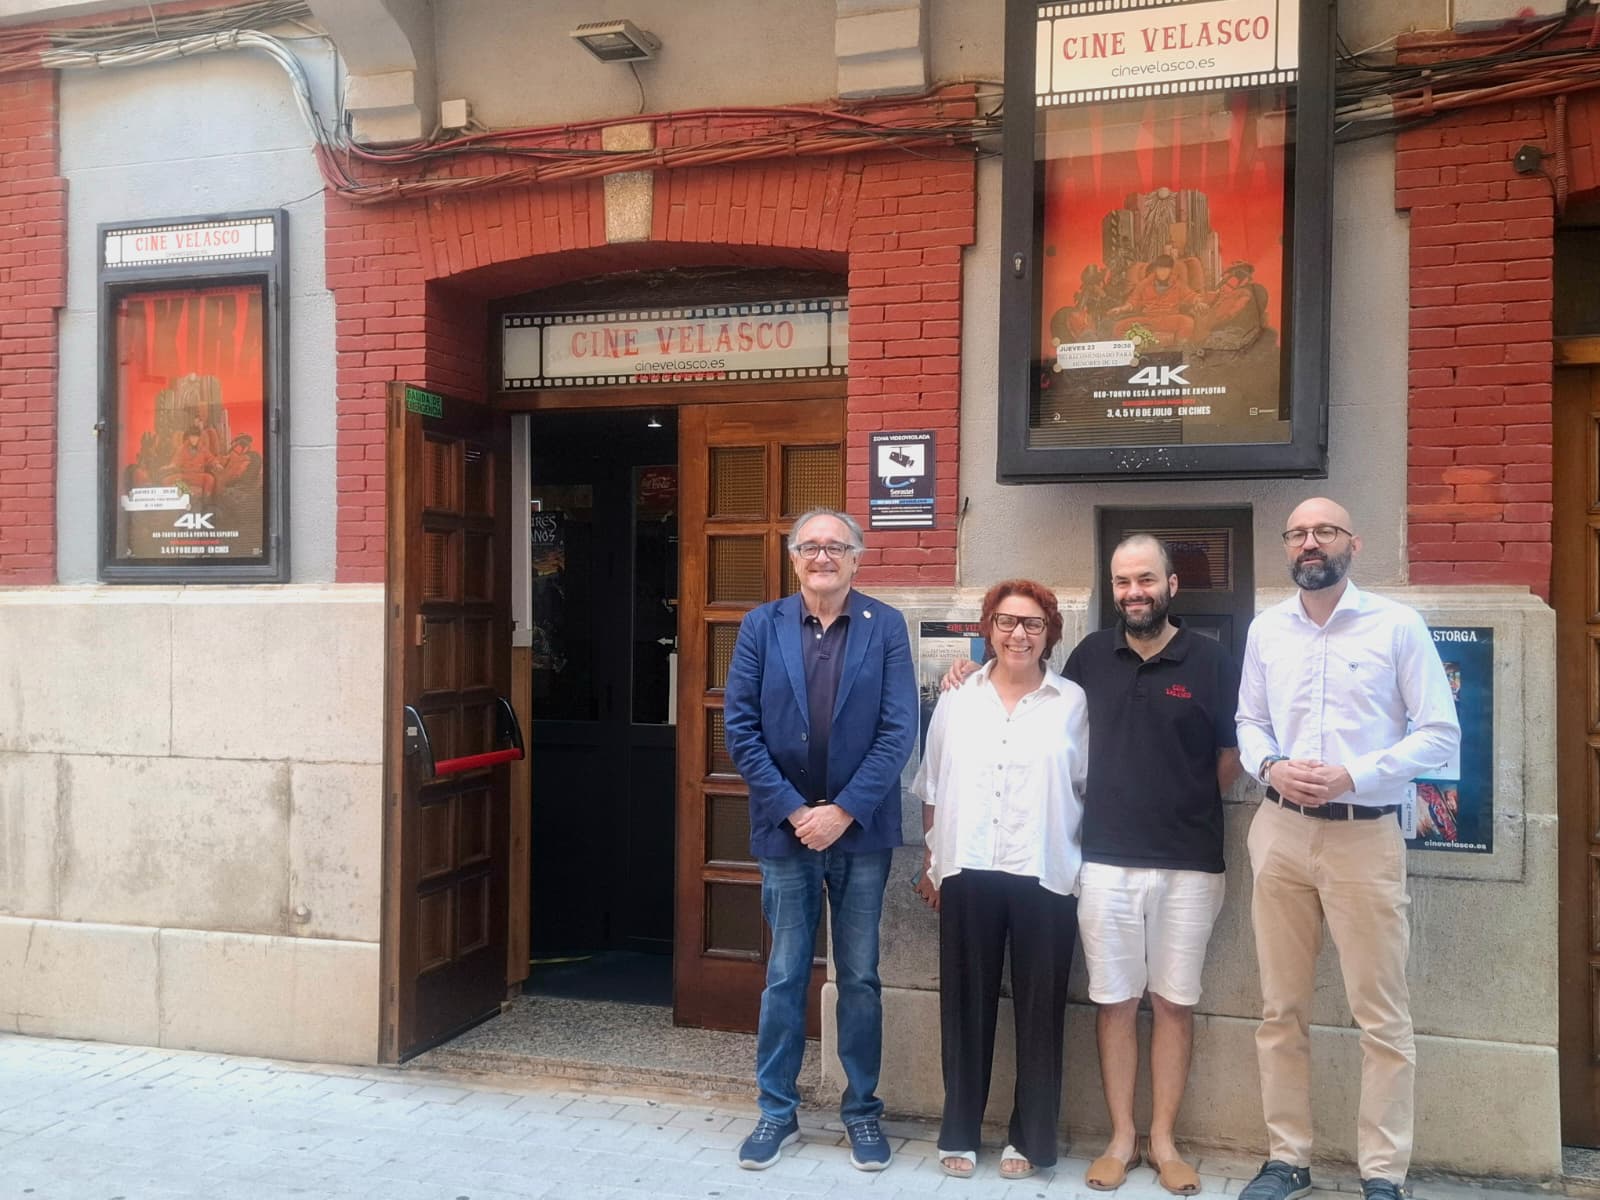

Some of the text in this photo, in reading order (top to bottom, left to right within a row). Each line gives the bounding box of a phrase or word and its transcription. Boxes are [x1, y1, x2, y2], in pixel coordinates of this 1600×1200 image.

[1062, 15, 1270, 61] CINE VELASCO
[1111, 57, 1216, 78] cinevelasco.es
[135, 229, 241, 251] CINE VELASCO
[570, 320, 795, 359] CINE VELASCO
[634, 358, 726, 372] cinevelasco.es
[1127, 364, 1191, 386] 4K
[1133, 388, 1149, 398] ESTÁ
[1151, 389, 1156, 397] A
[1157, 388, 1180, 397] PUNTO
[1182, 388, 1191, 396] DE
[1192, 386, 1226, 395] EXPLOTAR
[1129, 408, 1134, 417] Y
[1142, 408, 1151, 417] DE
[1152, 407, 1173, 416] JULIO
[1178, 406, 1188, 415] EN
[1188, 406, 1211, 415] CINES
[173, 512, 215, 529] 4K
[1429, 630, 1478, 642] STORGA
[1424, 839, 1487, 850] cinevelasco.es
